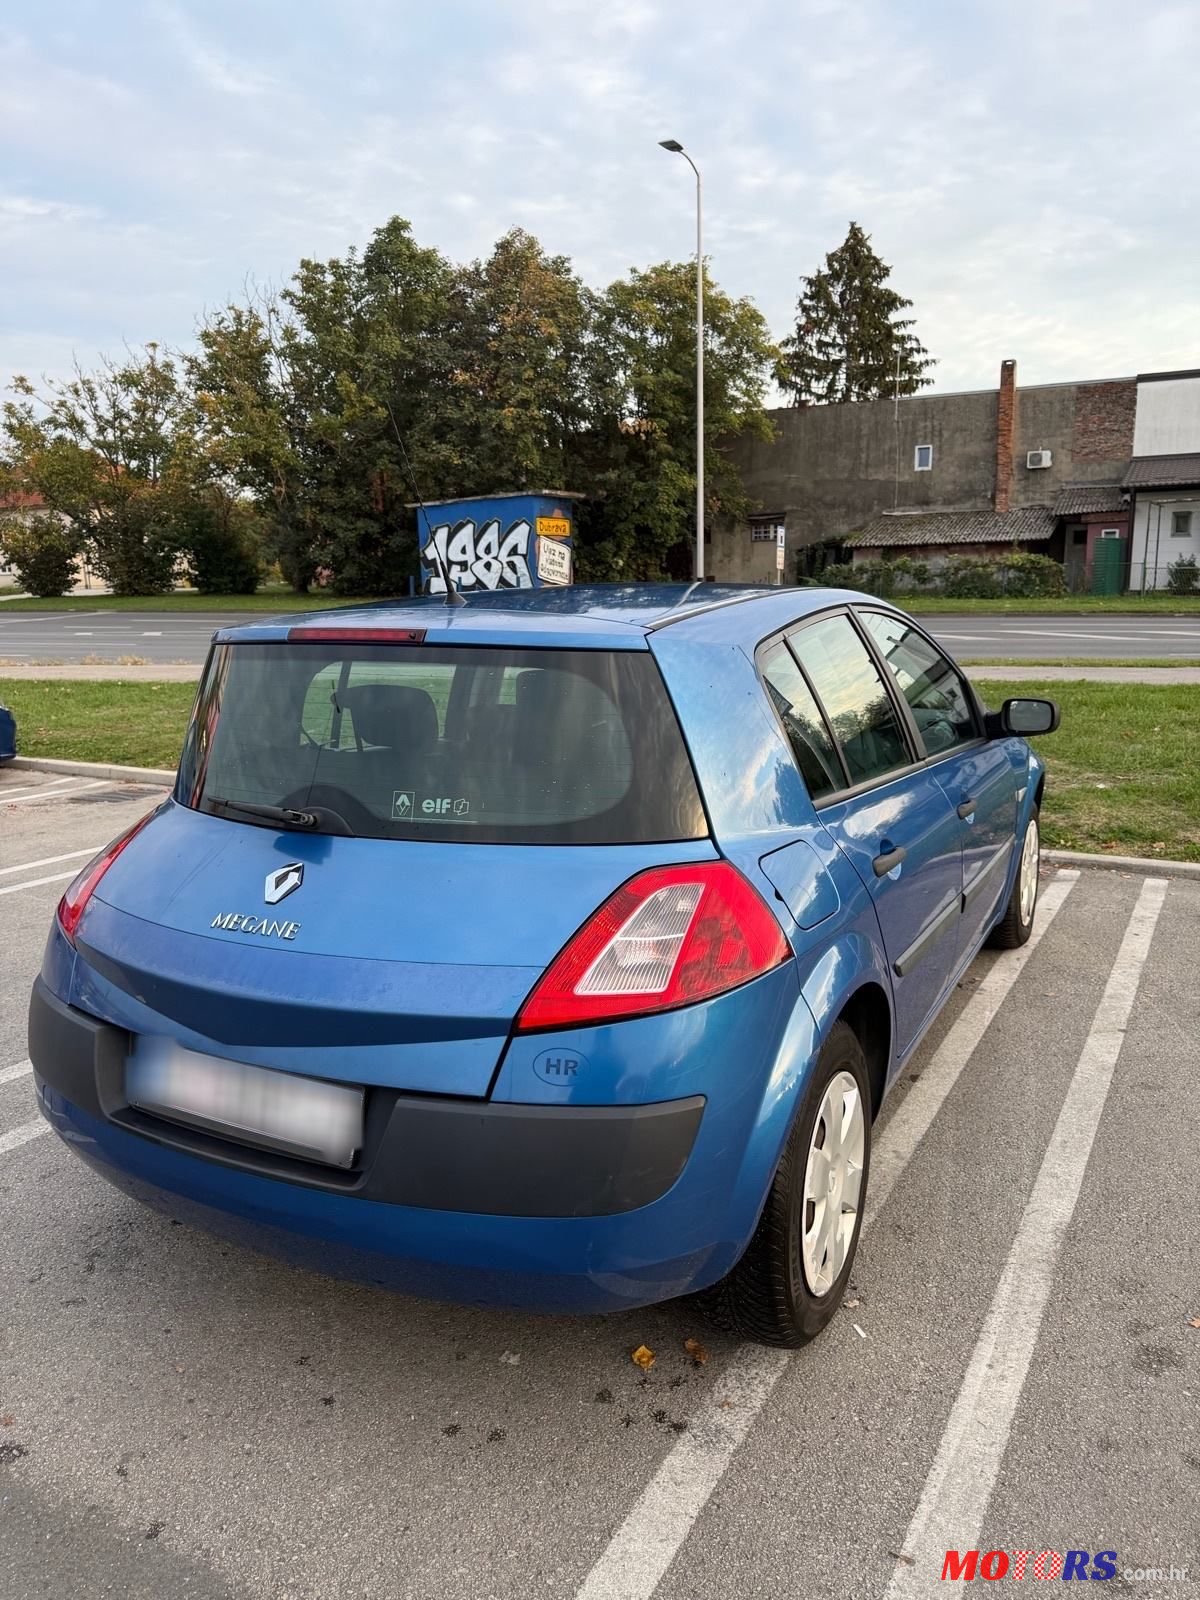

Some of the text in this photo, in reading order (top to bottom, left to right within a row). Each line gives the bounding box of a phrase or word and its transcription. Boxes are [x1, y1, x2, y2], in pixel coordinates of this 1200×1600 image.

[539, 521, 567, 533] Dubrava
[421, 519, 534, 594] 1986
[422, 798, 452, 814] elf
[209, 912, 301, 940] MEGANE
[545, 1057, 578, 1076] HR
